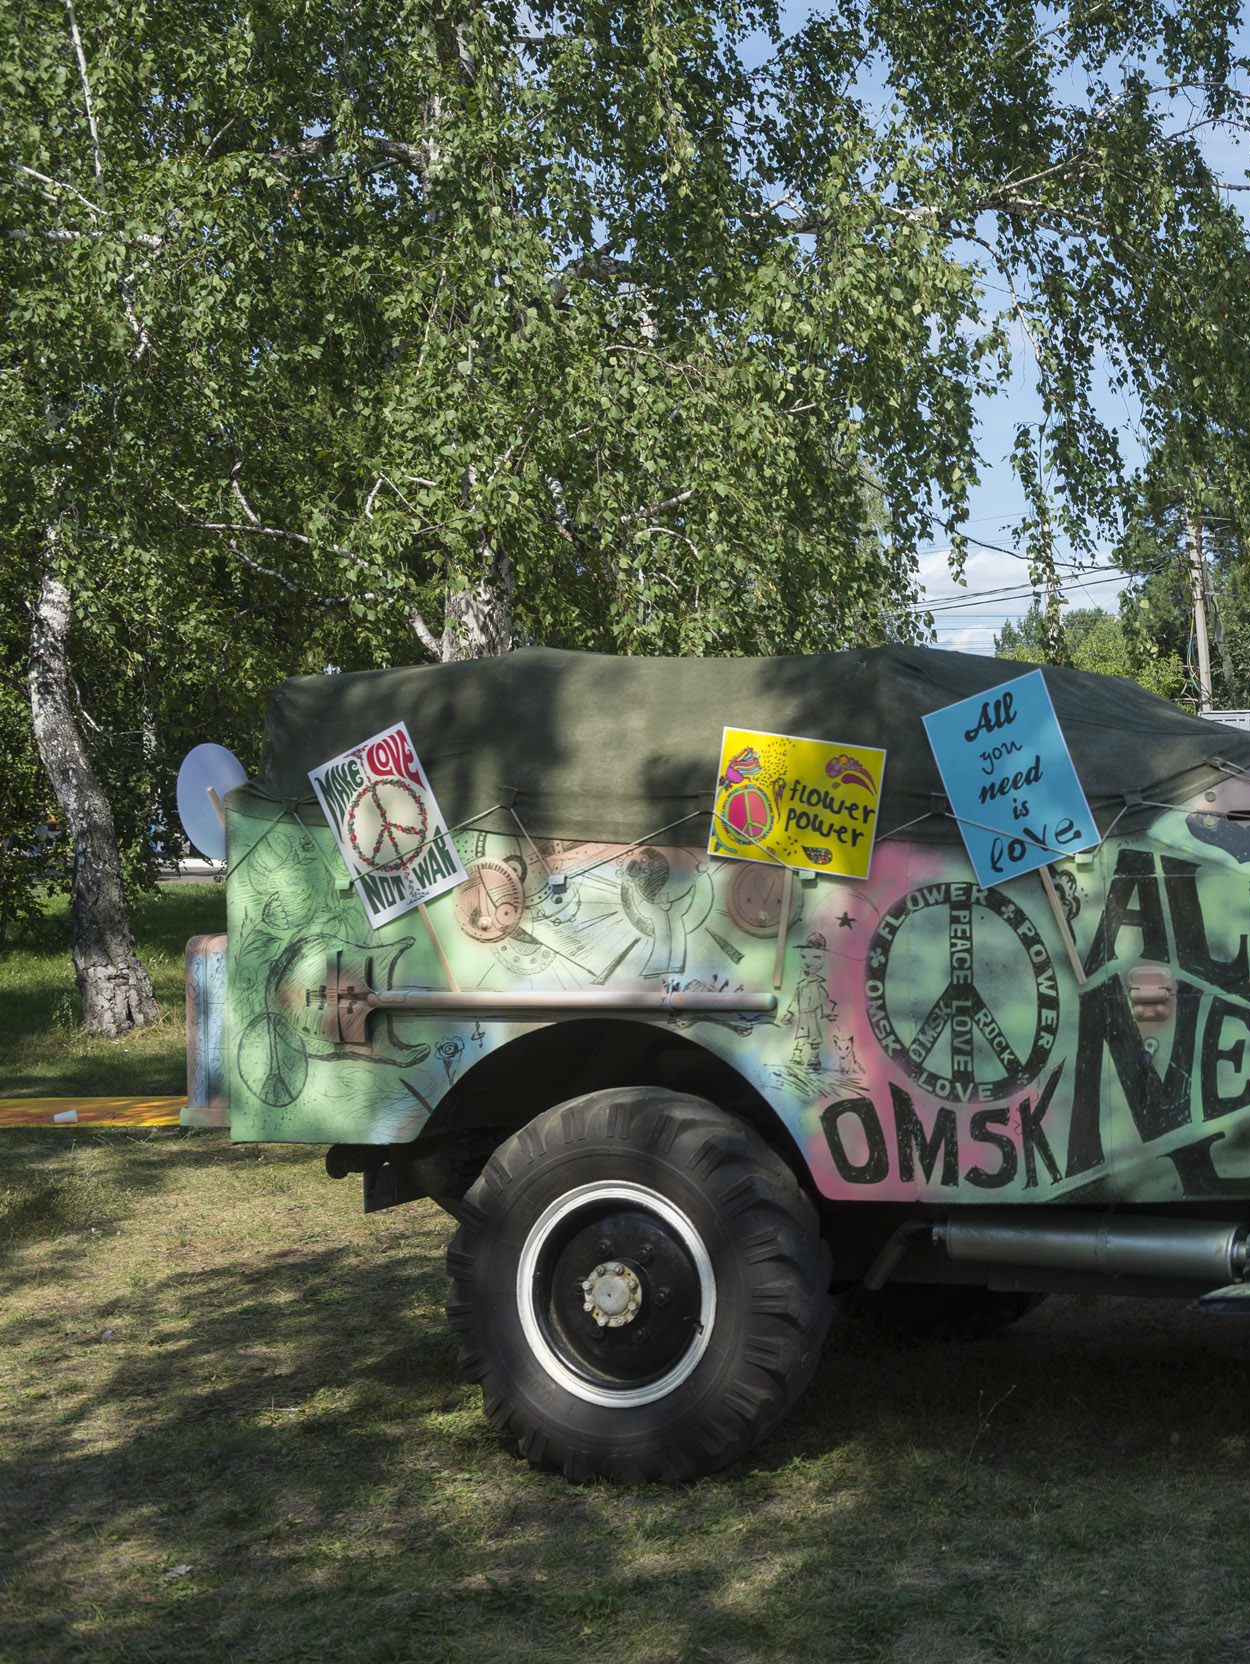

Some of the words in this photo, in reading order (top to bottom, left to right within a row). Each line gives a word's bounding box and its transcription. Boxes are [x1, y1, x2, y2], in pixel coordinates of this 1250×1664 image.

[964, 691, 1017, 742] All
[314, 759, 365, 845] MAKE
[366, 729, 427, 791] LOVE
[978, 755, 1043, 805] need
[979, 740, 1023, 775] you
[784, 807, 865, 847] power
[790, 778, 876, 824] flower
[1012, 797, 1030, 821] is
[352, 862, 406, 916] NOT
[411, 825, 458, 890] WAR
[990, 817, 1082, 873] love
[879, 883, 989, 941] FLOWER
[1016, 918, 1058, 1050] POWER
[950, 909, 971, 985] PEACE
[866, 979, 902, 1057] OMSK
[908, 1001, 951, 1063] OMSK
[974, 1007, 1015, 1067] ROCK
[951, 1000, 972, 1072] LOVE
[916, 1070, 994, 1102] LOVE
[820, 1056, 1067, 1190] OMSK
